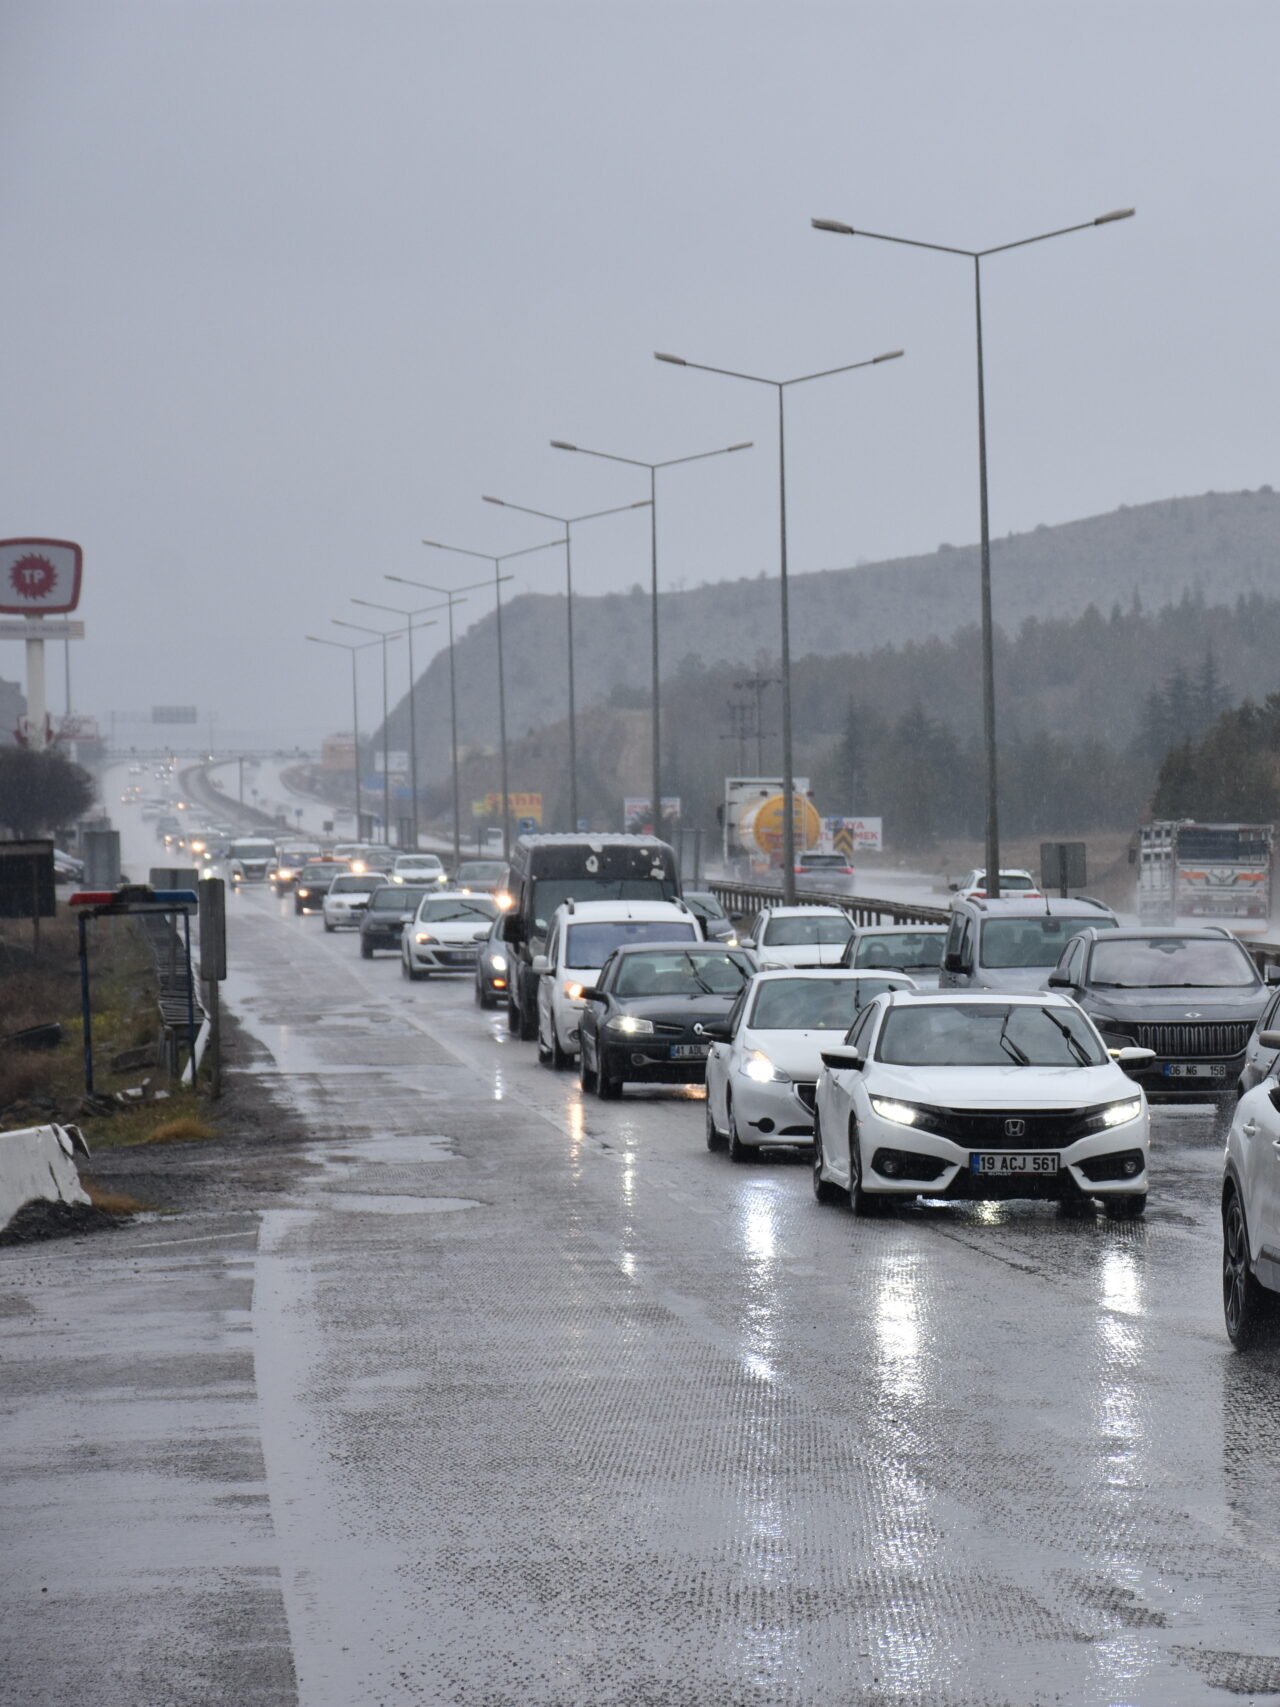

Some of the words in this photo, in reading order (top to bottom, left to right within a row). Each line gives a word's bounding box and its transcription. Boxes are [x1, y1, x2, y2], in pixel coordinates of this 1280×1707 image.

[22, 569, 45, 584] TP
[1169, 1065, 1181, 1076] 06
[1185, 1065, 1198, 1076] NG
[1209, 1065, 1225, 1076] 158
[981, 1156, 995, 1170] 19
[1000, 1156, 1027, 1171] ACJ
[1032, 1157, 1057, 1171] 561
